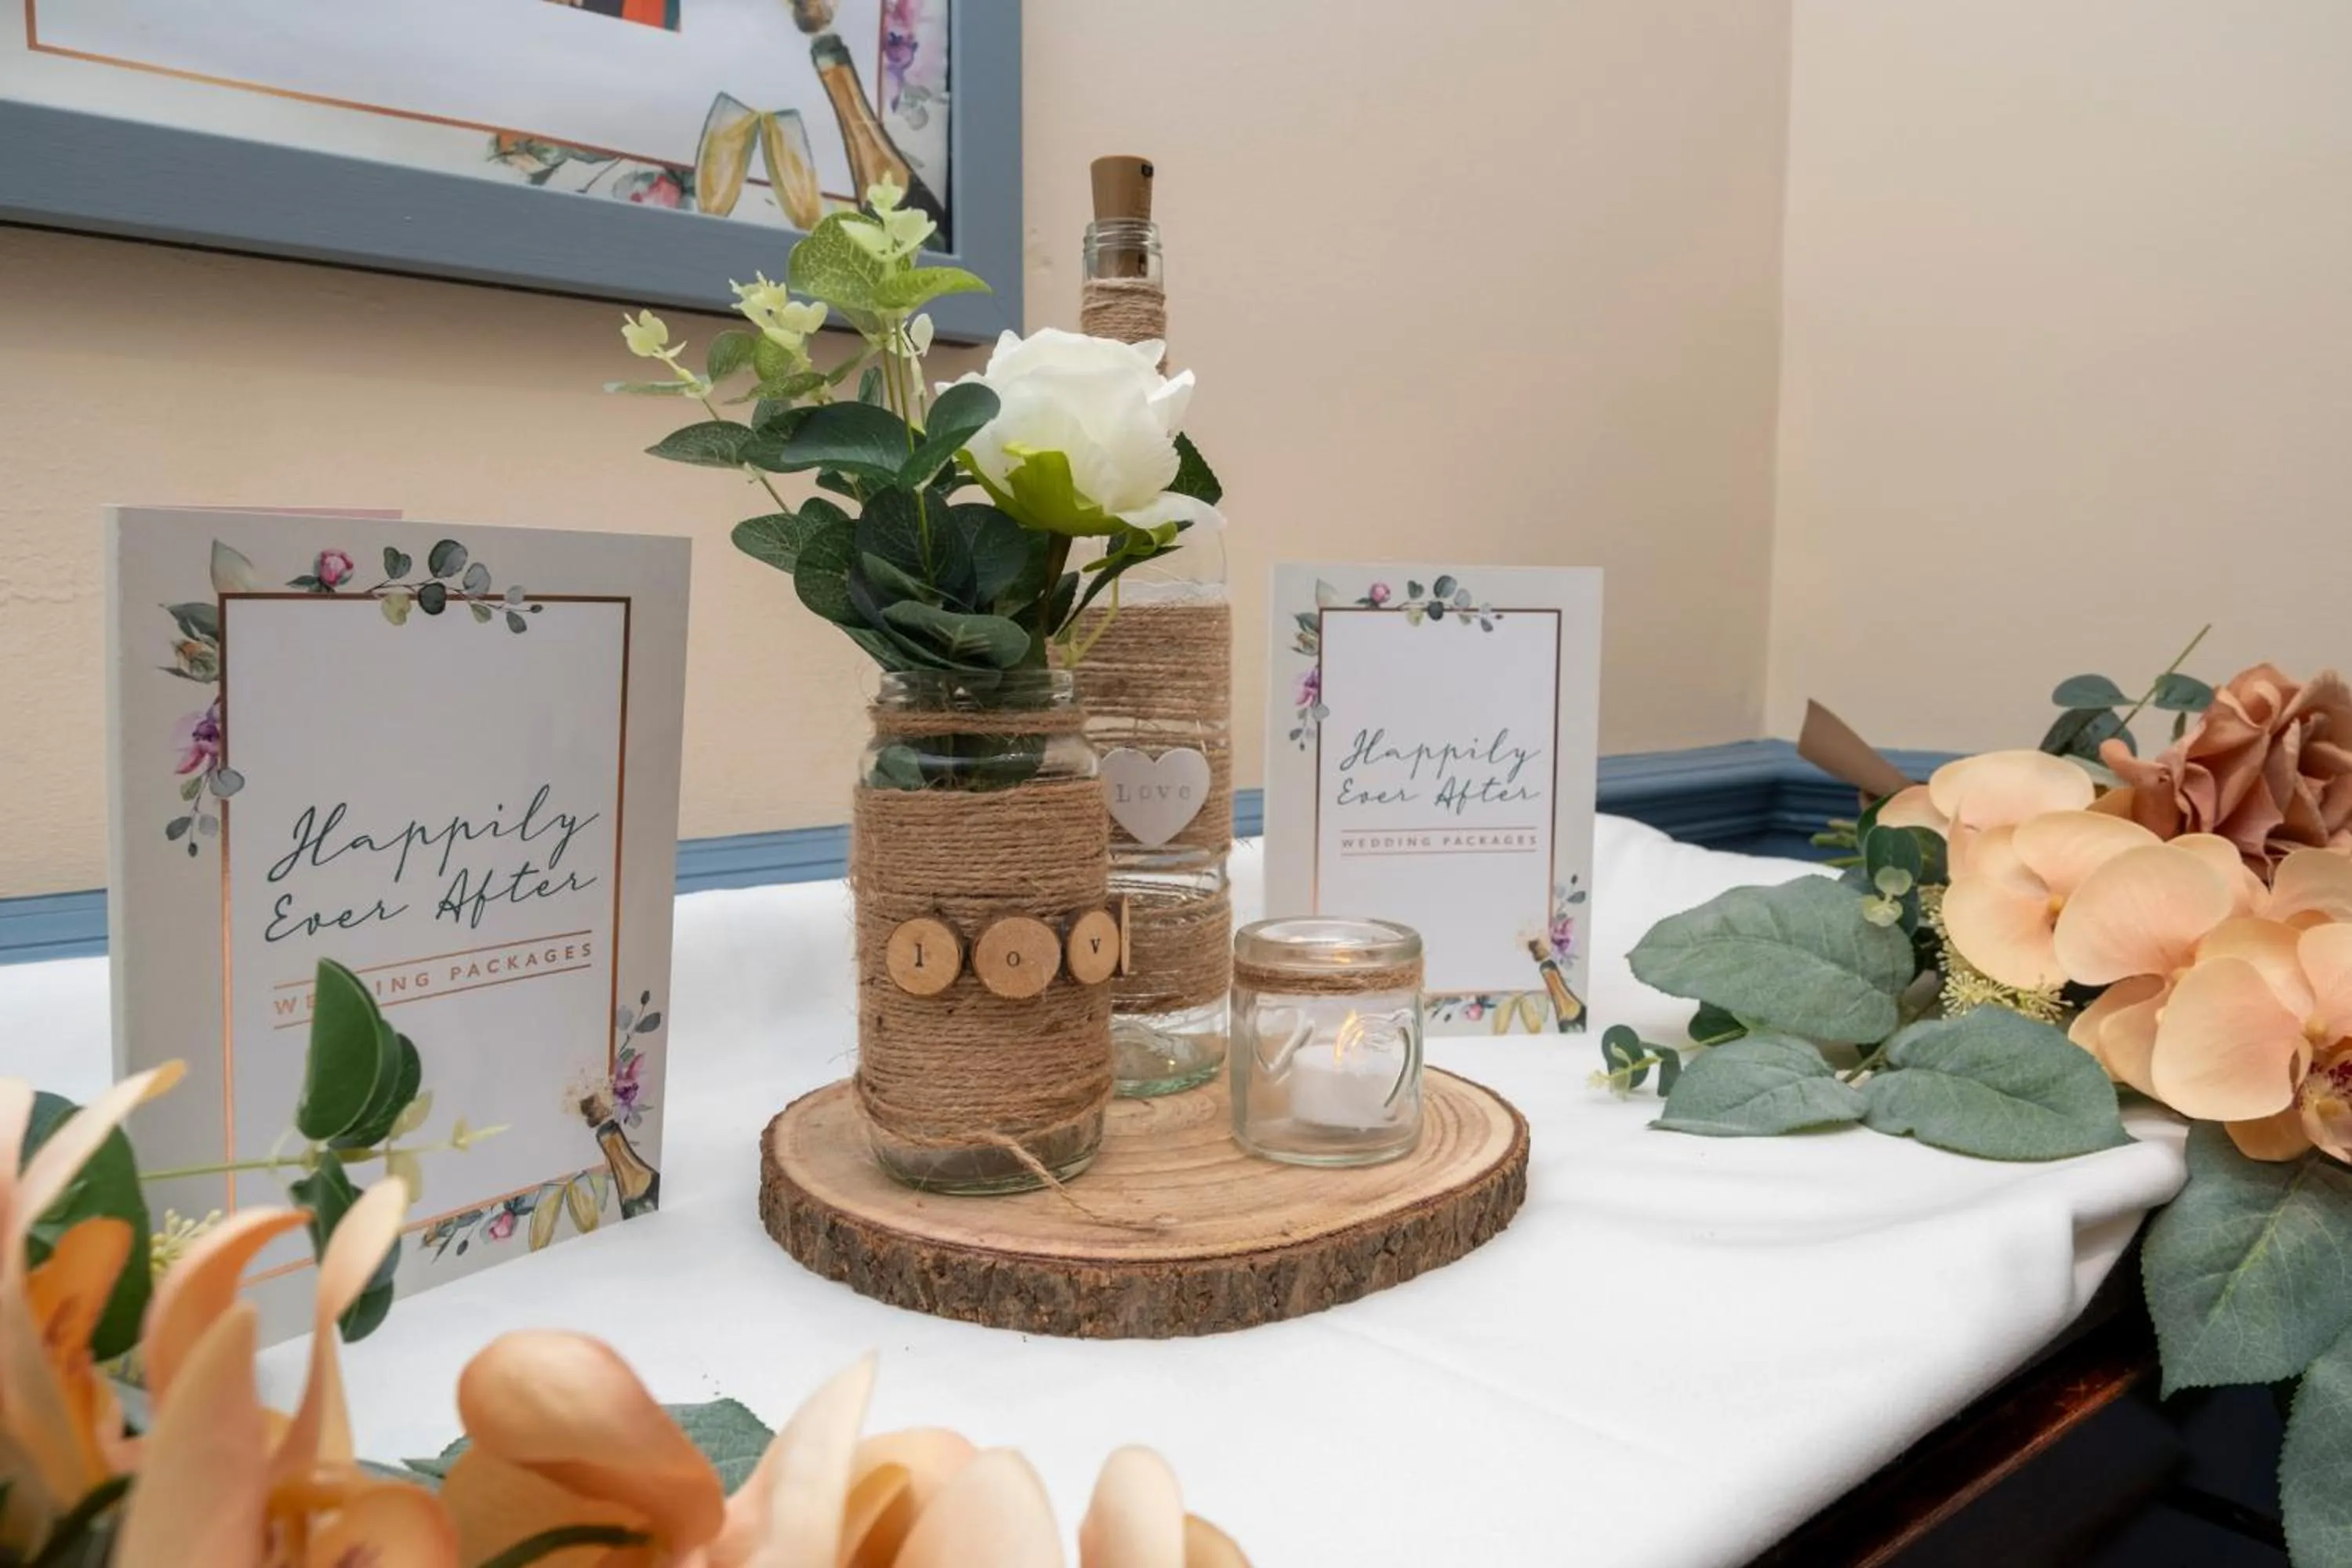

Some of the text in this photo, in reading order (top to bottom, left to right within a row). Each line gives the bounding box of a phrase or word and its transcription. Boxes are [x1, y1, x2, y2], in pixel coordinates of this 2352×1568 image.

[1339, 728, 1541, 783] Happily
[1115, 783, 1191, 804] Love
[1337, 776, 1541, 815] Ever After
[267, 784, 600, 883] Happily
[1341, 835, 1537, 849] WEDDING PACKAGES
[265, 862, 598, 942] Ever After
[274, 942, 593, 1015] WEING PACKAGES
